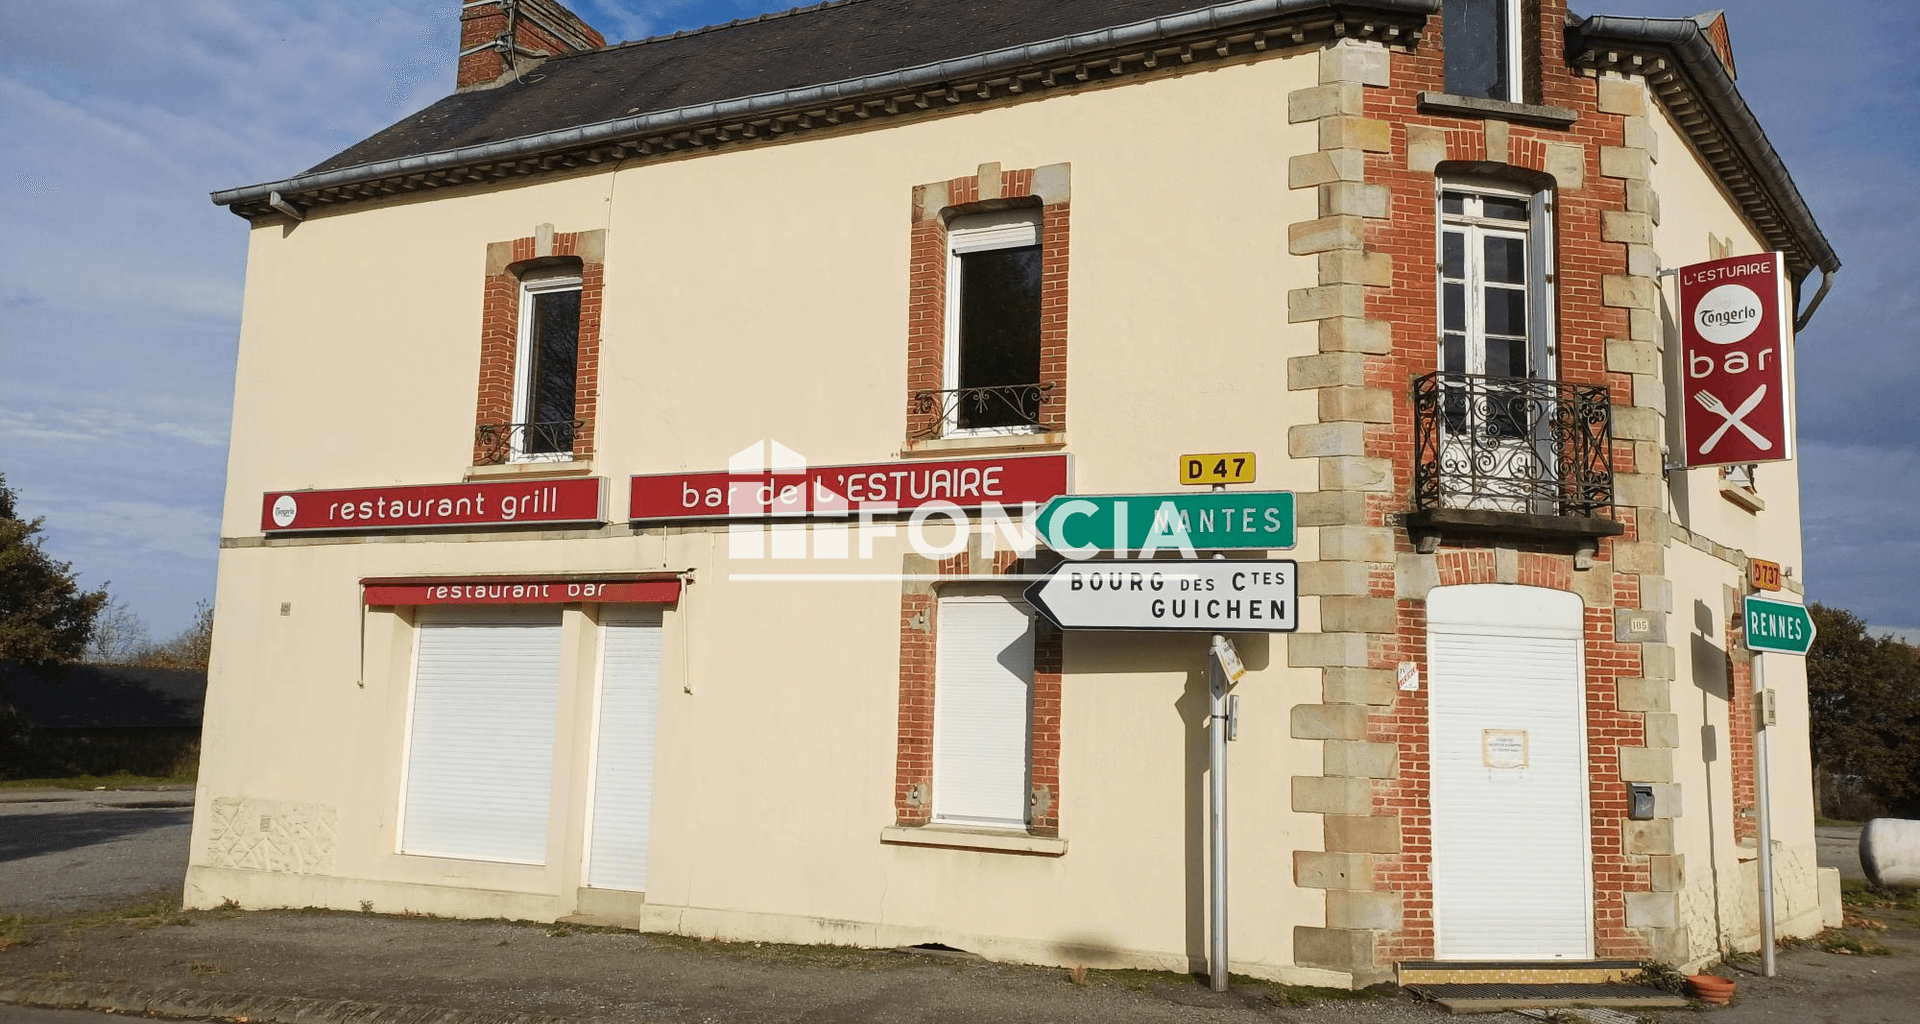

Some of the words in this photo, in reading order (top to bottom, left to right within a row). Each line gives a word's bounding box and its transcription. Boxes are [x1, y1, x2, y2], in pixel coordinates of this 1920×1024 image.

[1683, 261, 1771, 286] L'ESTUAIRE
[1698, 305, 1756, 327] Tongerlo
[1689, 348, 1773, 379] bar
[681, 481, 738, 508] bar
[755, 477, 799, 506] de
[815, 465, 1005, 503] L'ESTUAIRE
[329, 491, 485, 520] restaurant
[500, 487, 558, 521] grill
[1153, 507, 1282, 534] NANTES
[426, 584, 550, 600] restaurant
[566, 583, 606, 597] bar
[1070, 571, 1165, 592] BOURG
[1180, 578, 1216, 592] DES
[1151, 599, 1286, 620] GUICHEN
[1632, 620, 1648, 631] 105
[1751, 611, 1802, 640] RENNES
